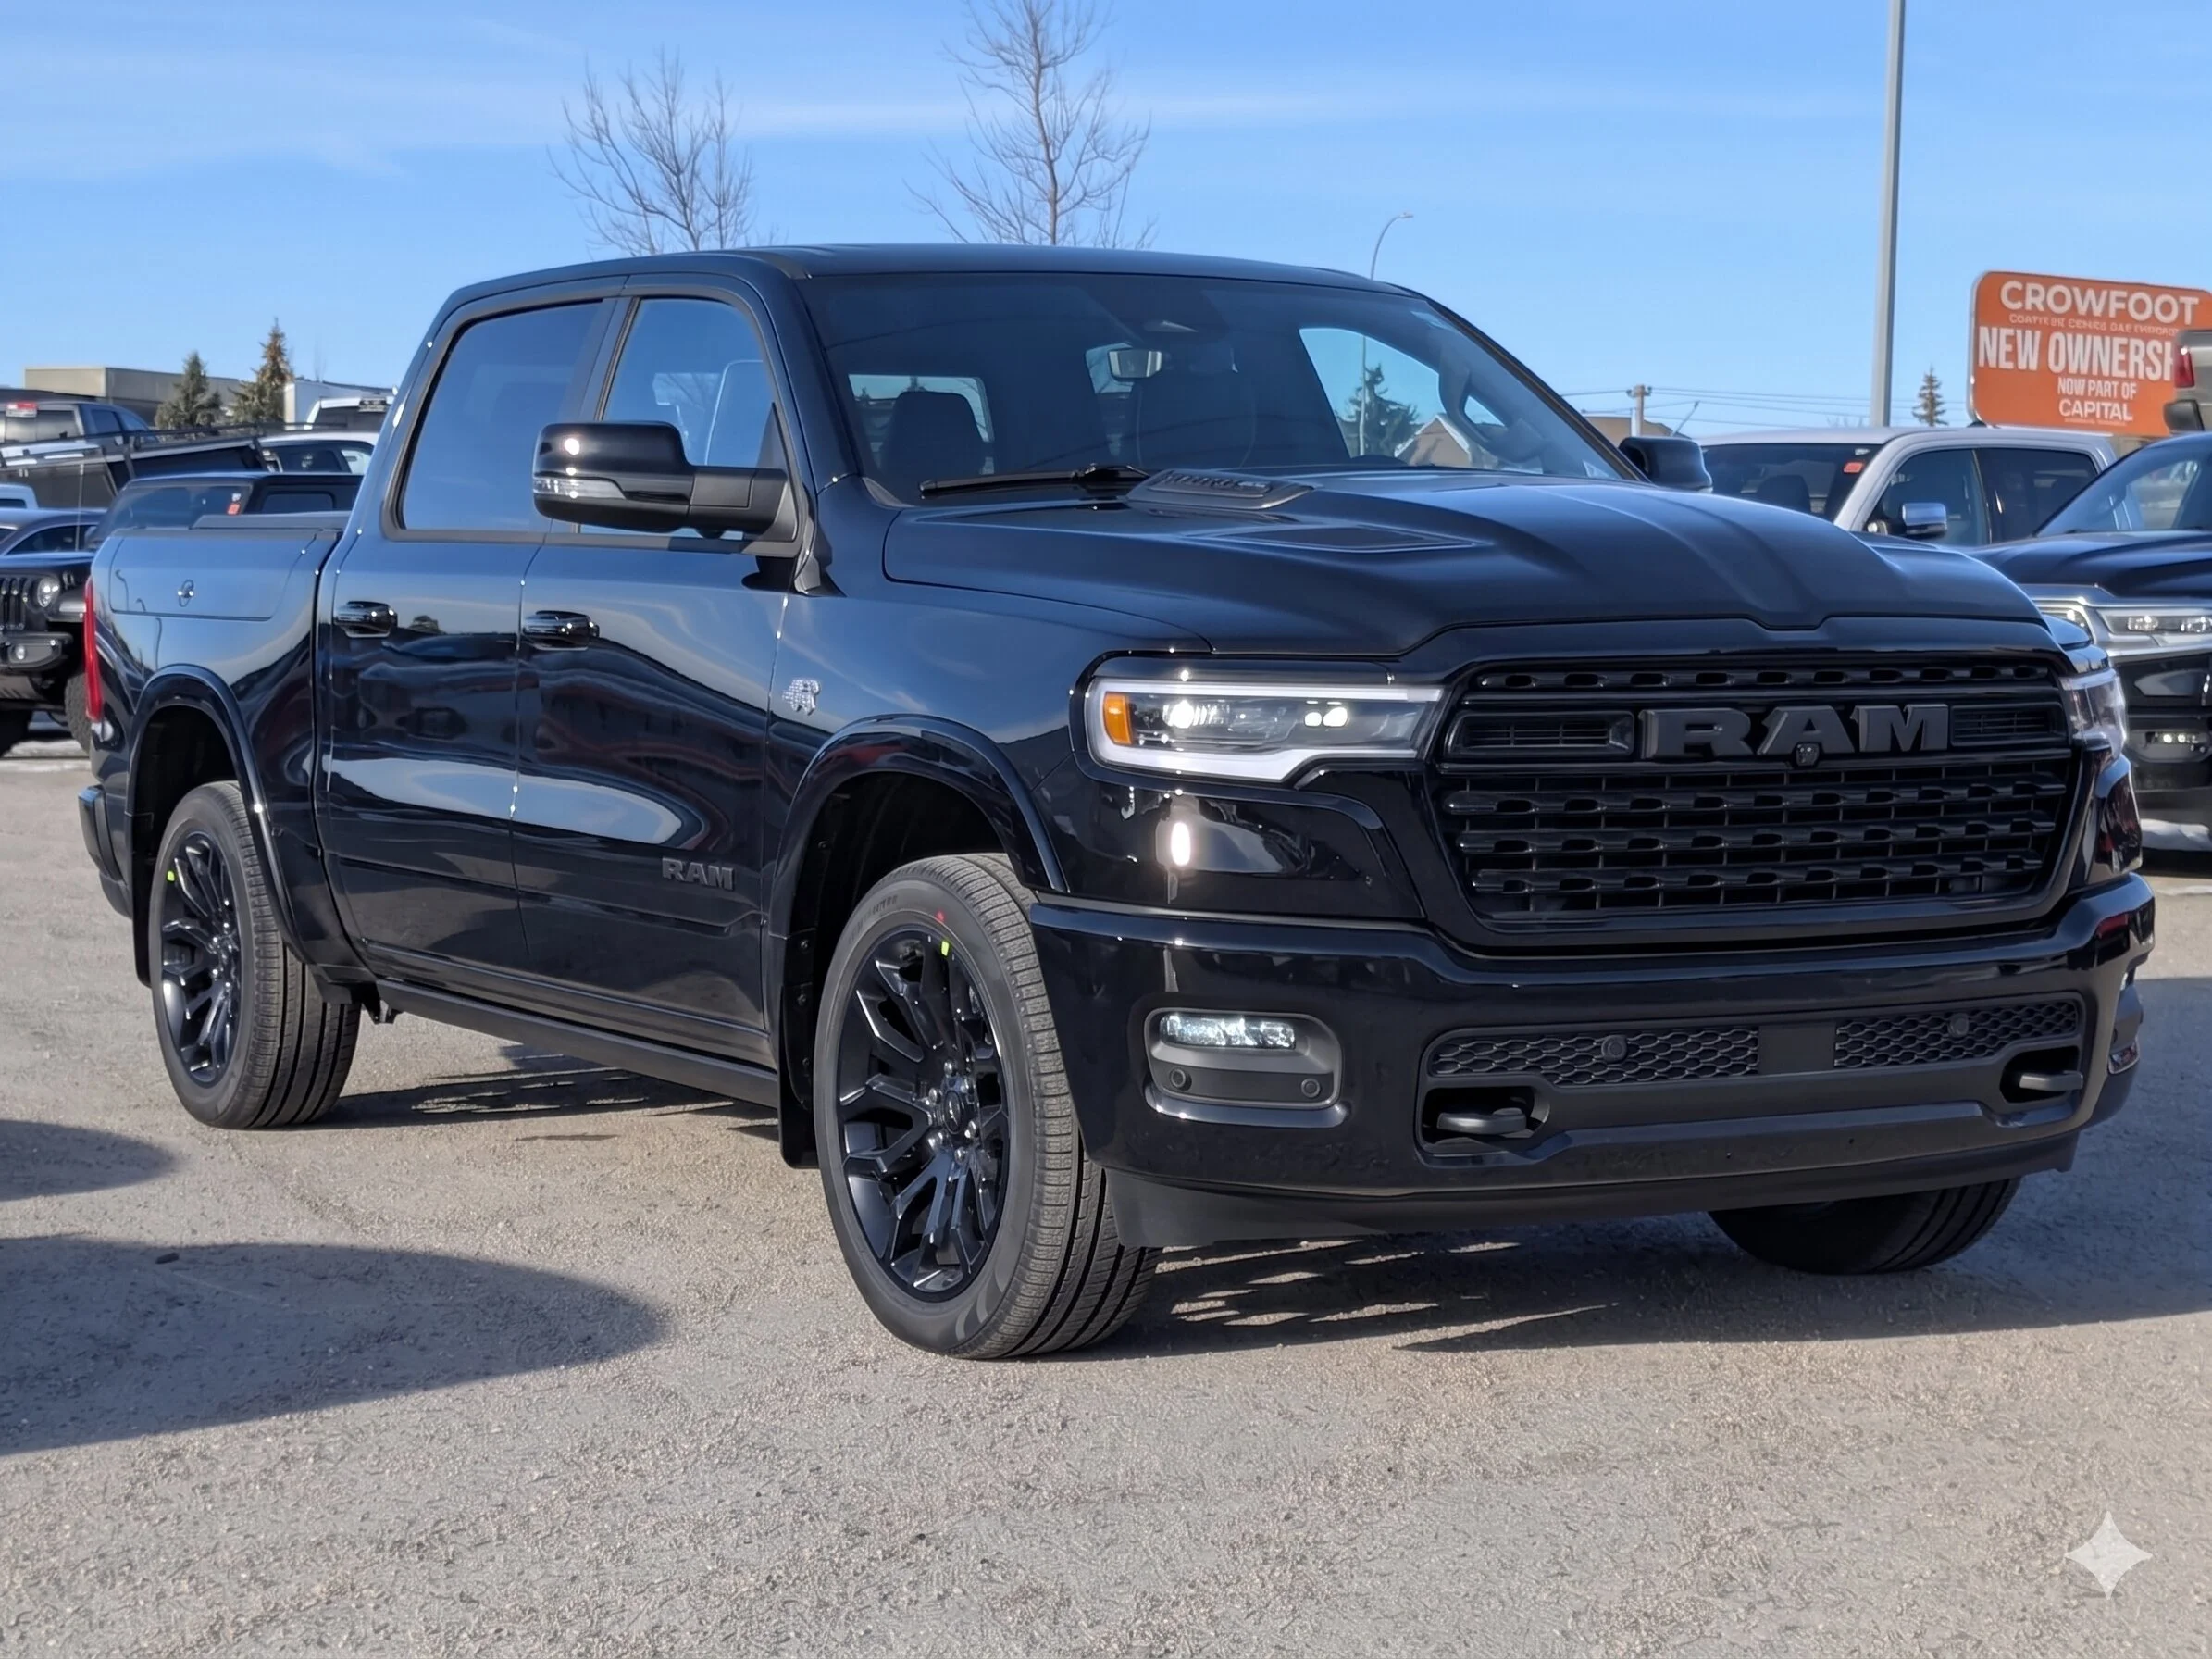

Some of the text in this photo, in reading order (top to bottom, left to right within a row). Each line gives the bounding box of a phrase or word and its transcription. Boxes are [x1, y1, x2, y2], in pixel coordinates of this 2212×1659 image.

[2000, 281, 2200, 325] CROWFOOT
[1978, 326, 2042, 371] NEW
[2057, 377, 2137, 401] NOW PART OF
[2058, 399, 2133, 421] CAPITAL
[1638, 704, 1948, 760] RAM
[662, 857, 734, 891] RAM
